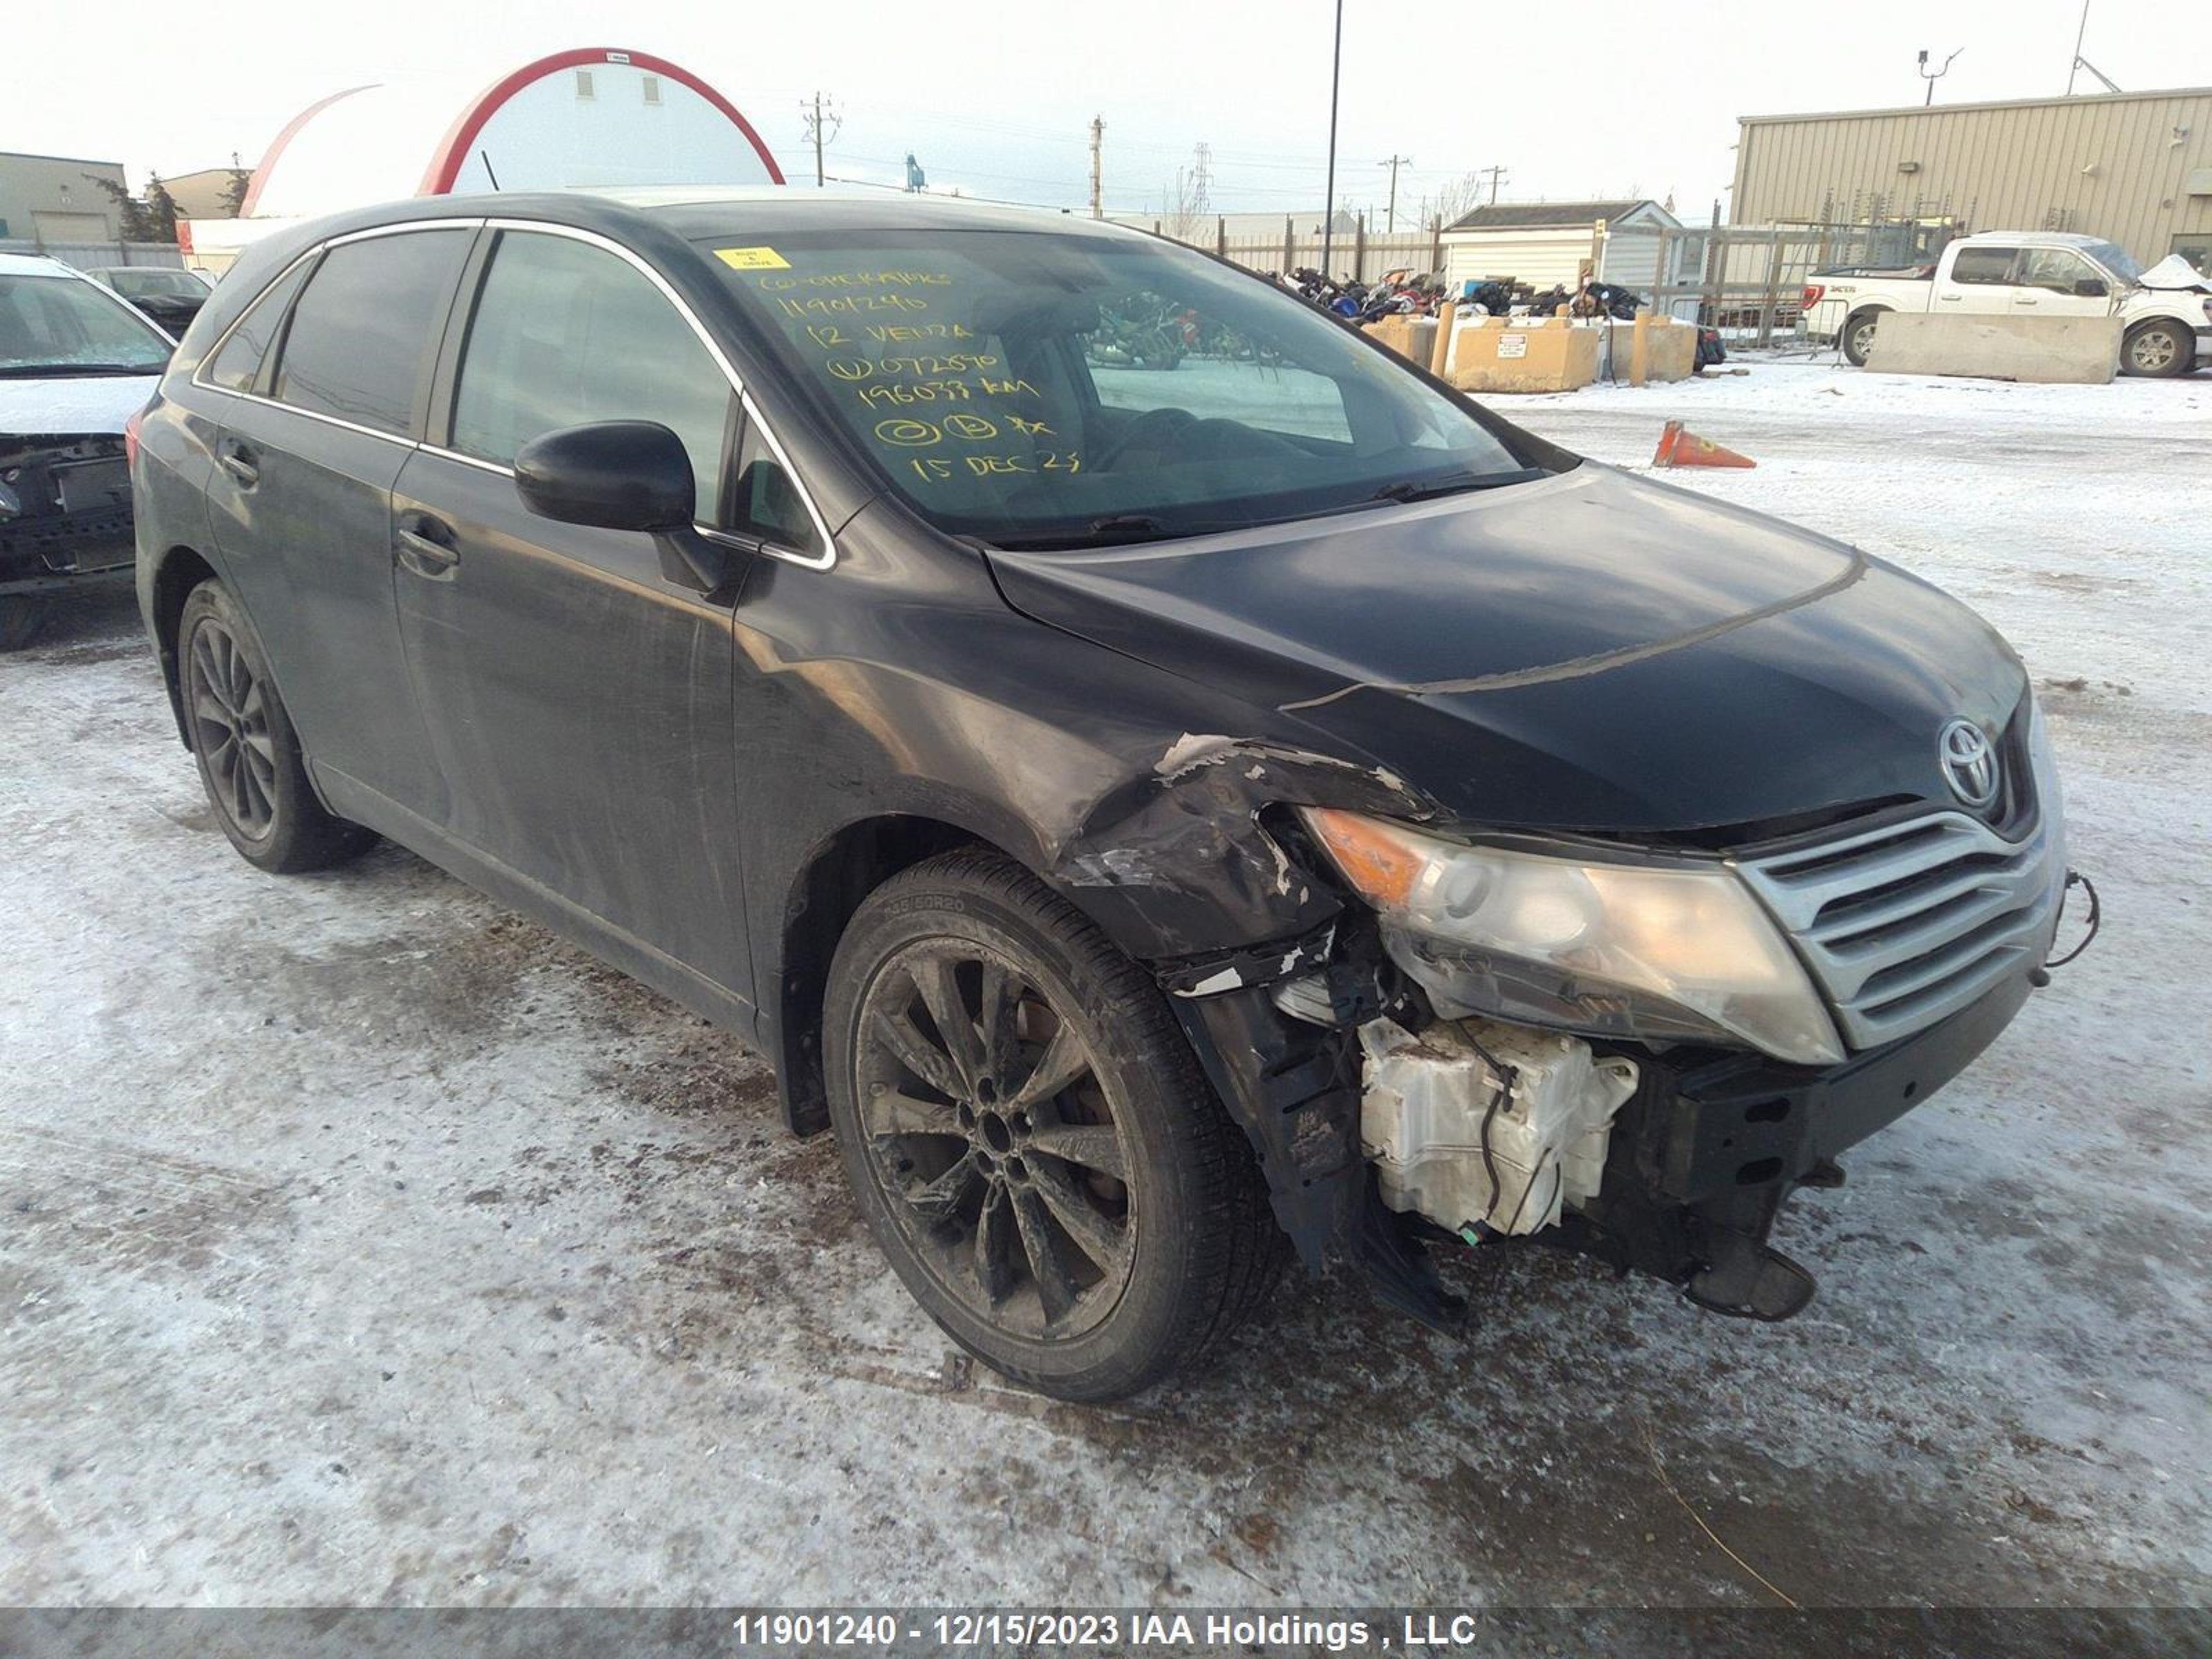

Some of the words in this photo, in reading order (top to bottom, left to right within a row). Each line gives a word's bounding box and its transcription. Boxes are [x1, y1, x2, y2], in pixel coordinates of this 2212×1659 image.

[777, 294, 928, 317] 11901240
[806, 325, 852, 348] 12
[966, 455, 1037, 476] DEC
